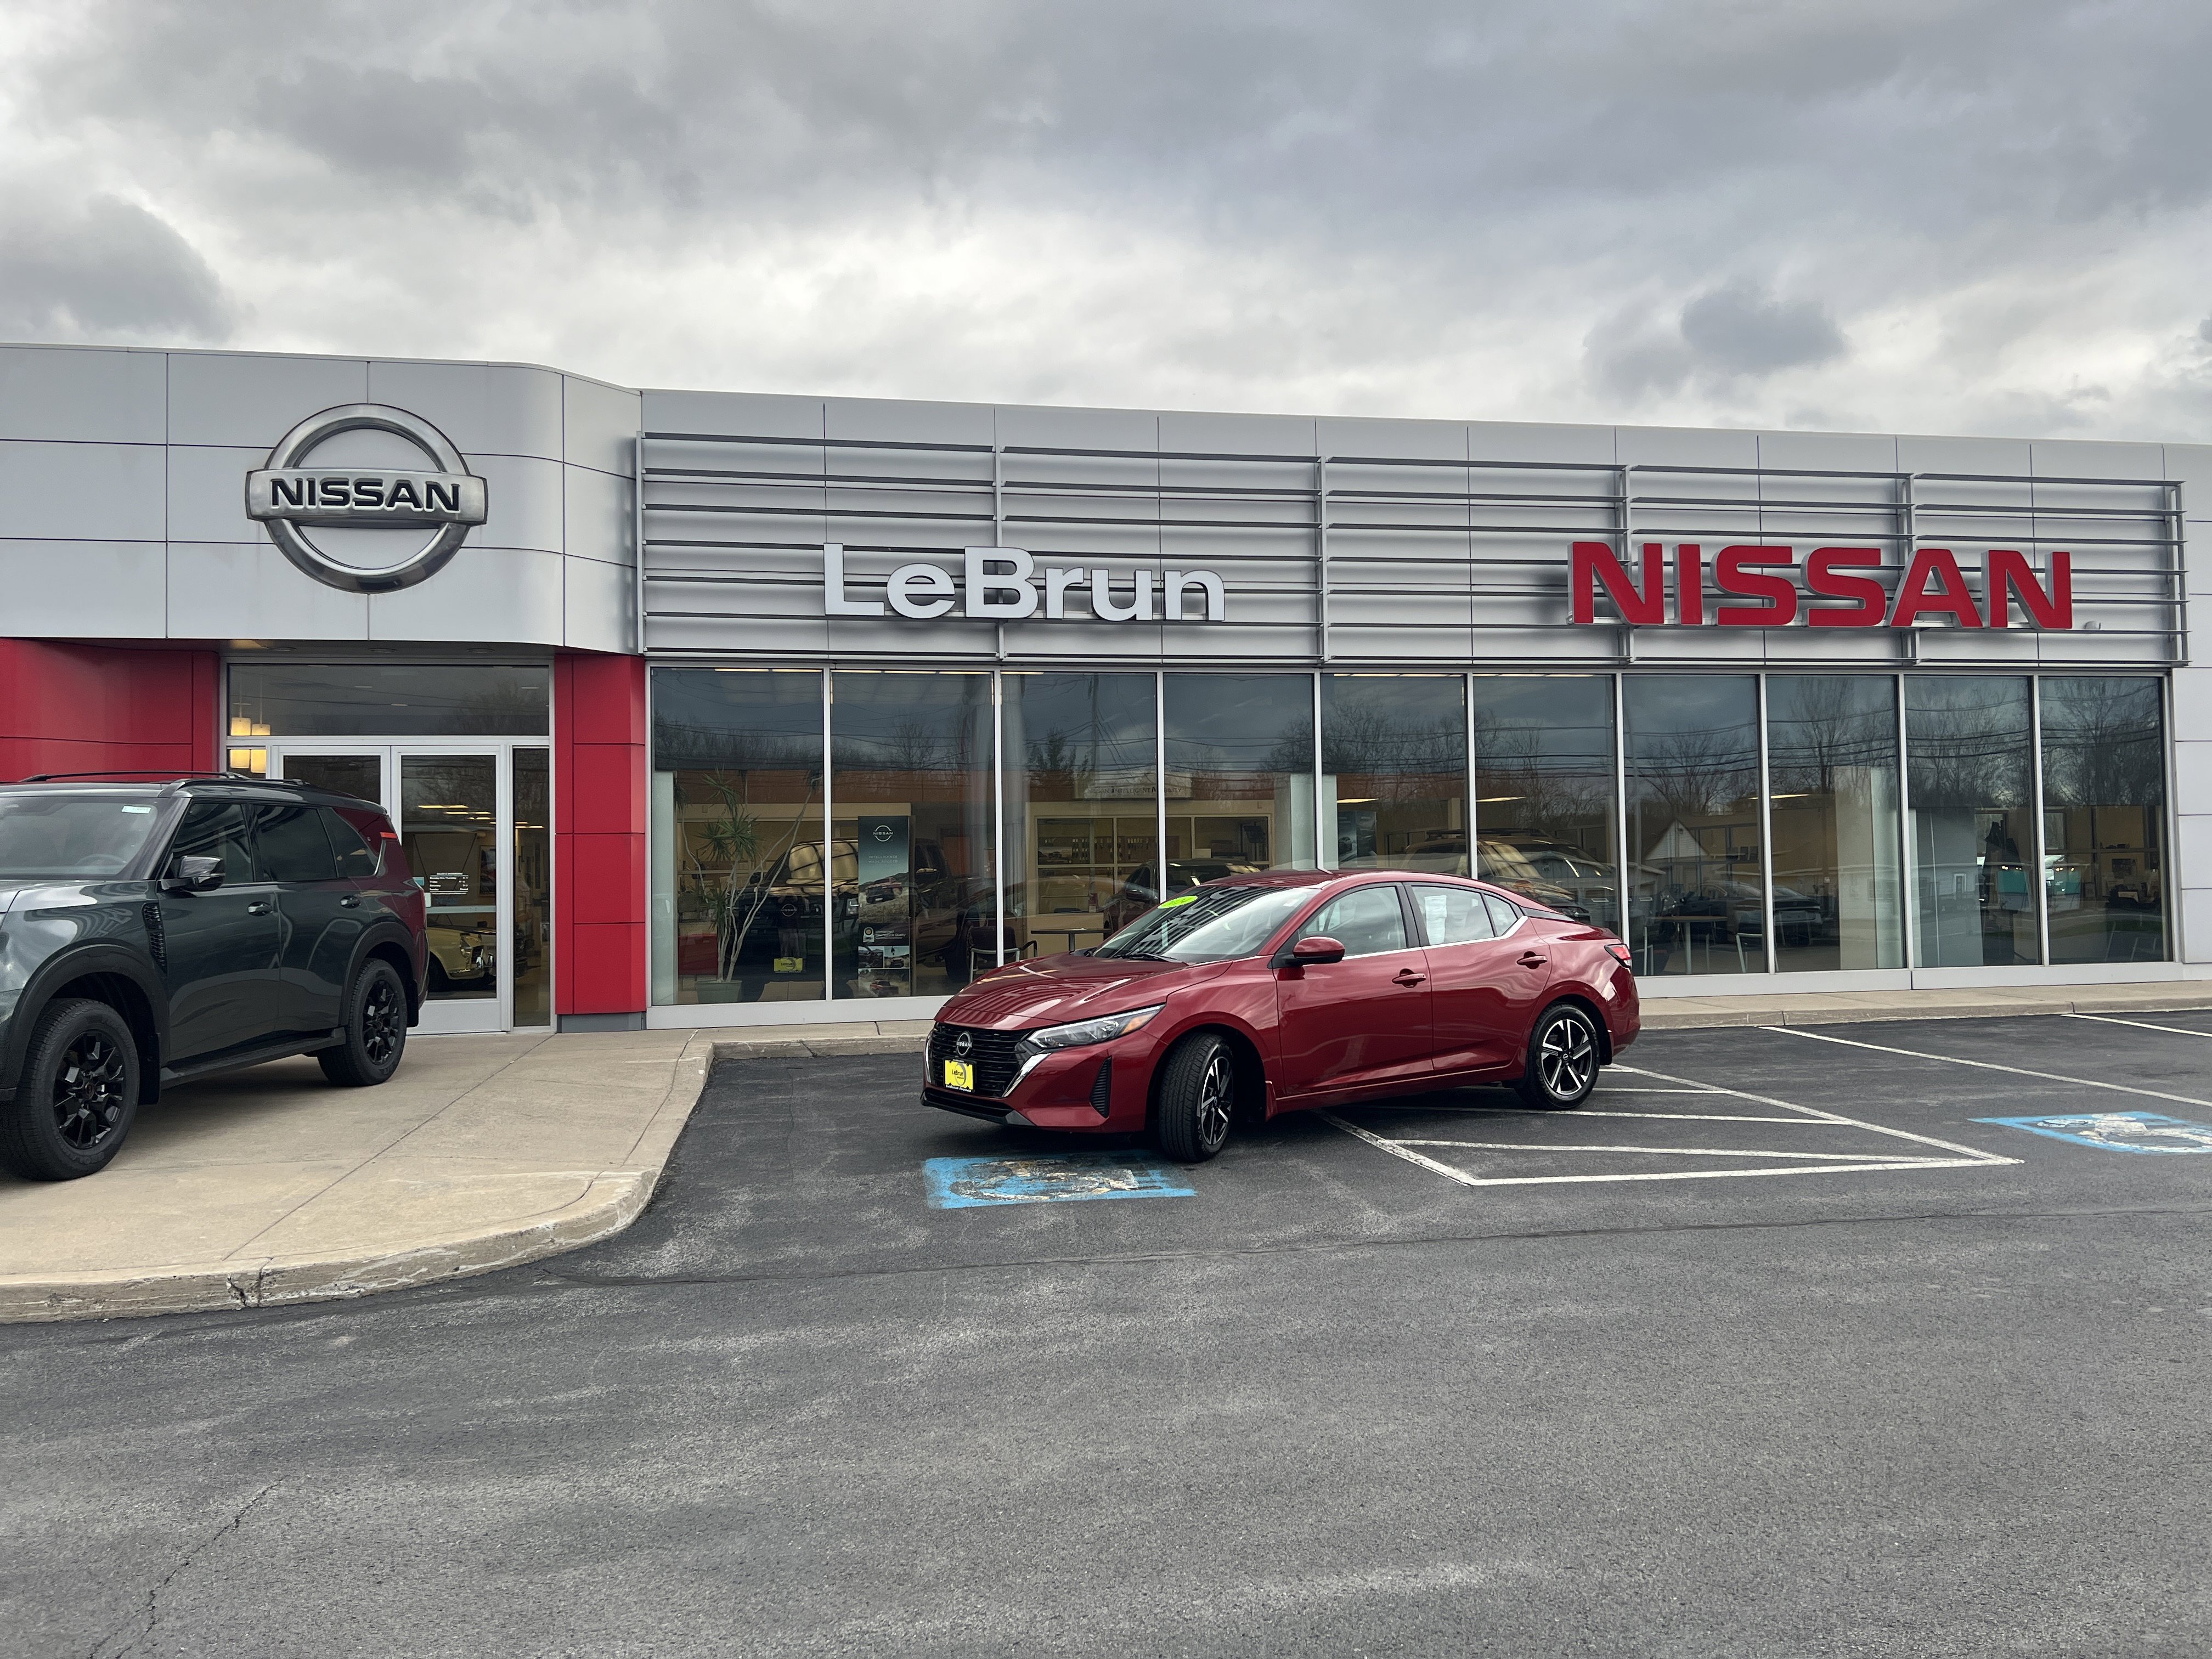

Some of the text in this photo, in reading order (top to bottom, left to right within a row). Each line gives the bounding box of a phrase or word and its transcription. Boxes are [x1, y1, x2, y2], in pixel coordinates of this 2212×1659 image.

[270, 477, 461, 514] NISSAN
[823, 543, 1224, 622] LeBrun
[1568, 541, 2072, 629] NISSAN
